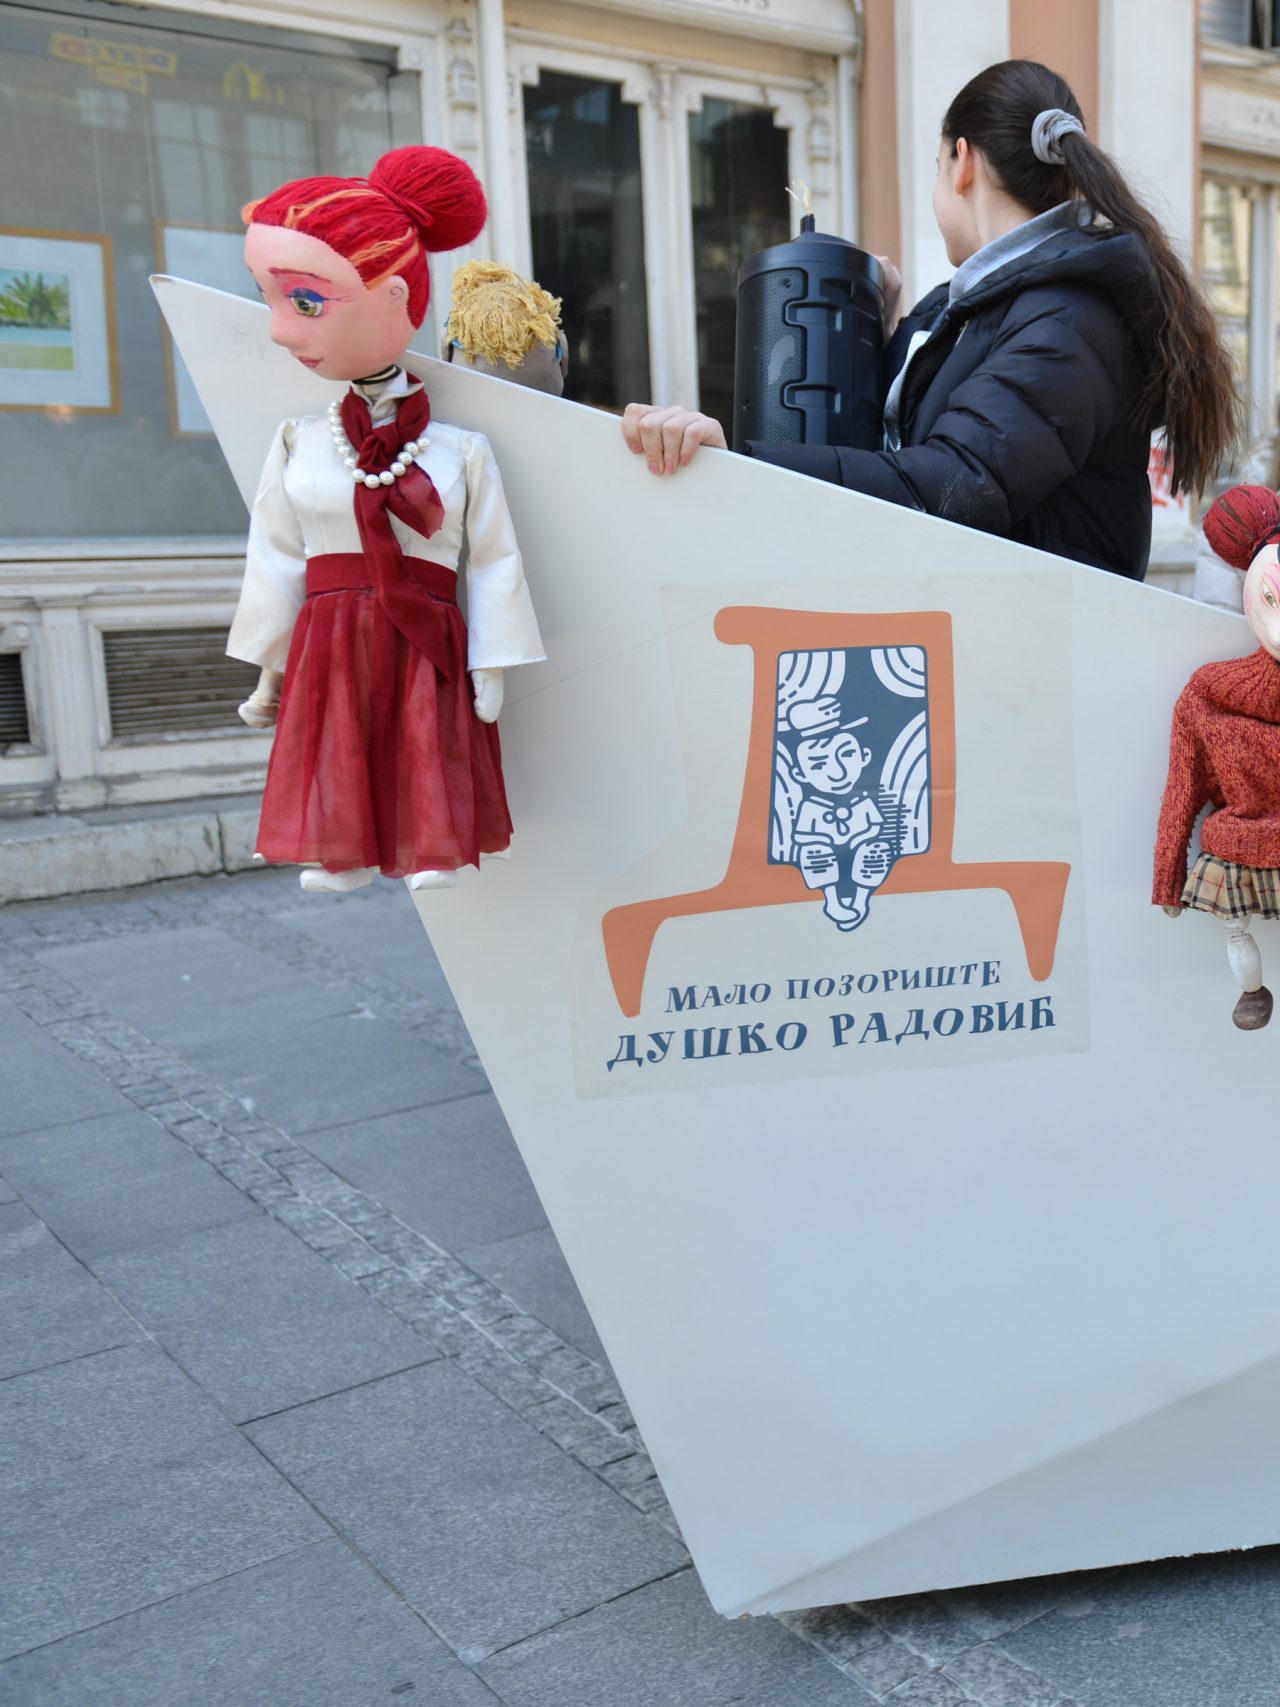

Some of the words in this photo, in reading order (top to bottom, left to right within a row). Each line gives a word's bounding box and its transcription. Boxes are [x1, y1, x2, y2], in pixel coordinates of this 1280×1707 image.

[664, 983, 772, 1013] МАЛО
[785, 960, 1002, 1000] ПОЗОРИШТЕ
[606, 1022, 808, 1073] ДУШКО
[828, 995, 1057, 1049] РАДОВИЋ
